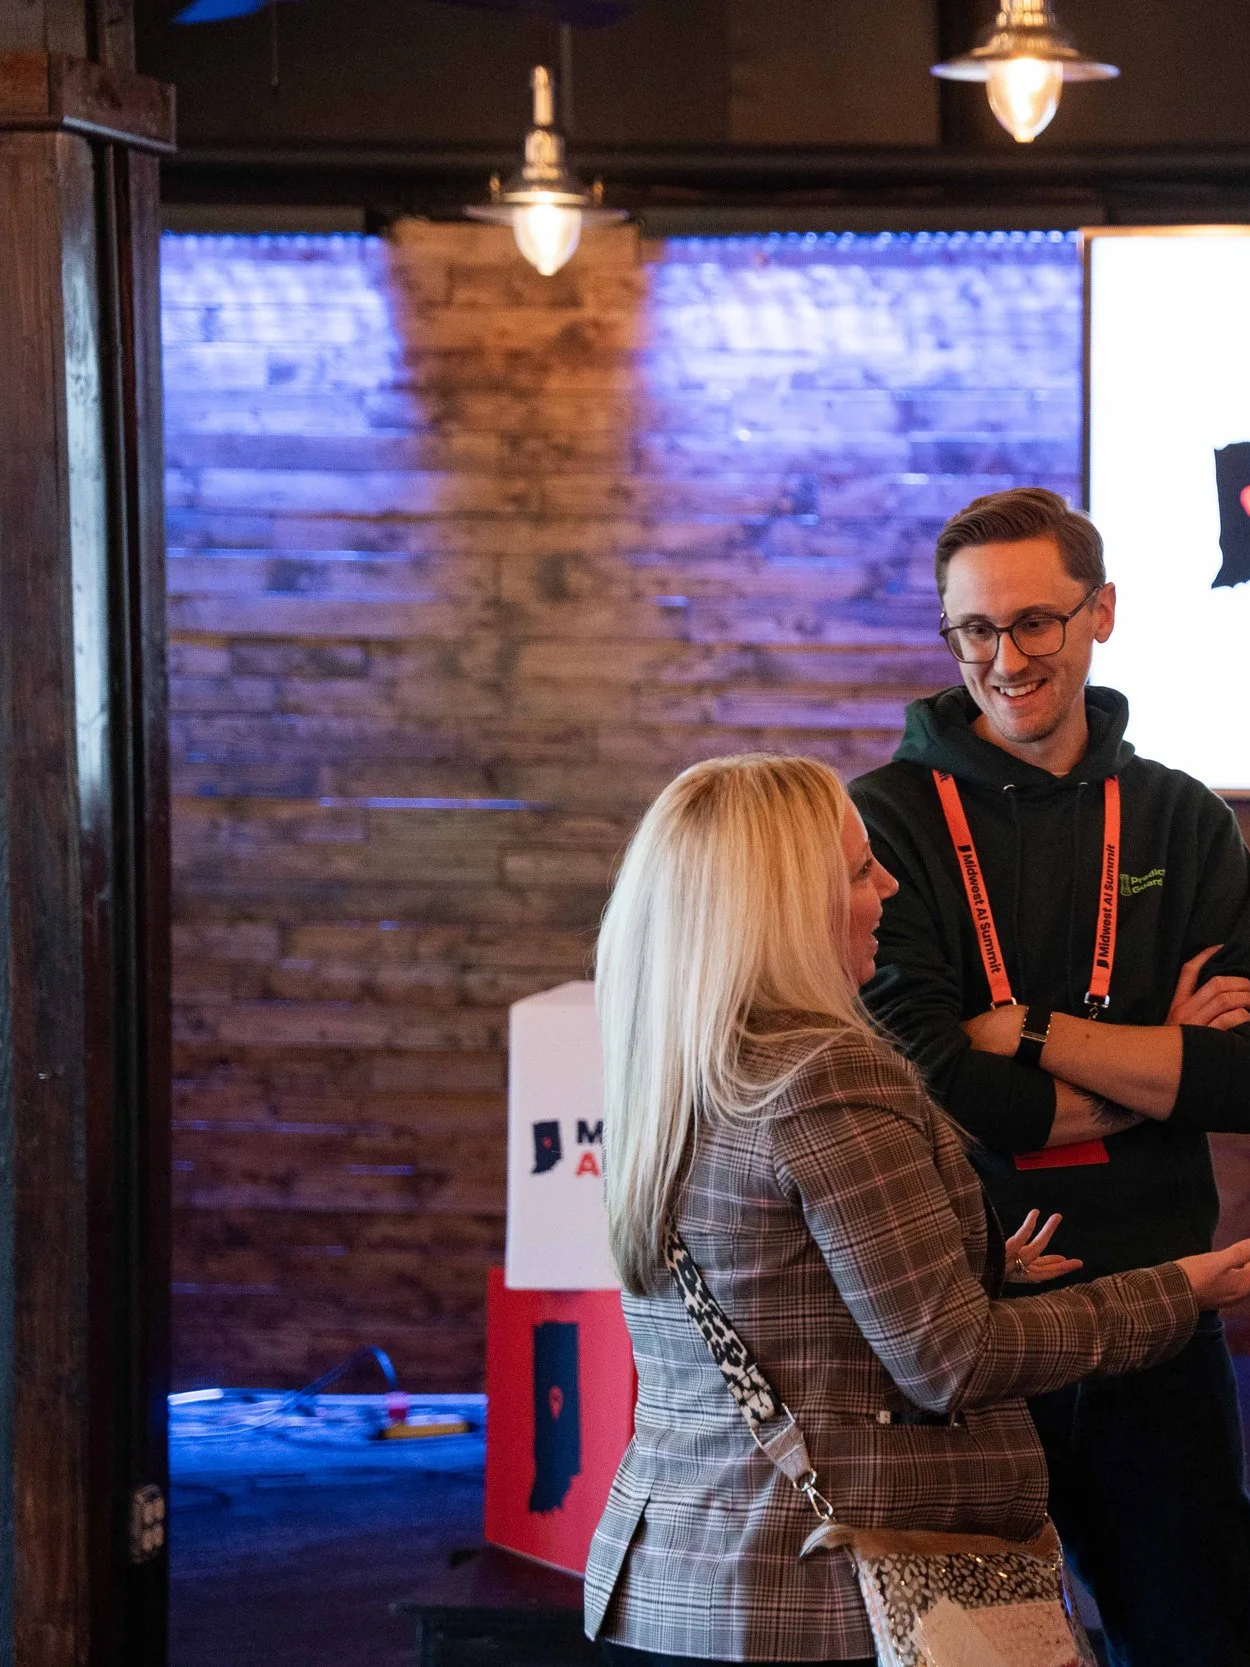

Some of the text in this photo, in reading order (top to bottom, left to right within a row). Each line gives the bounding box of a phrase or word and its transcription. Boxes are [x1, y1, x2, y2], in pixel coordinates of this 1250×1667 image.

[962, 853, 1002, 975] Midwest AI Summit
[1098, 843, 1116, 958] Midwest AI Summit
[1132, 878, 1163, 894] Guard
